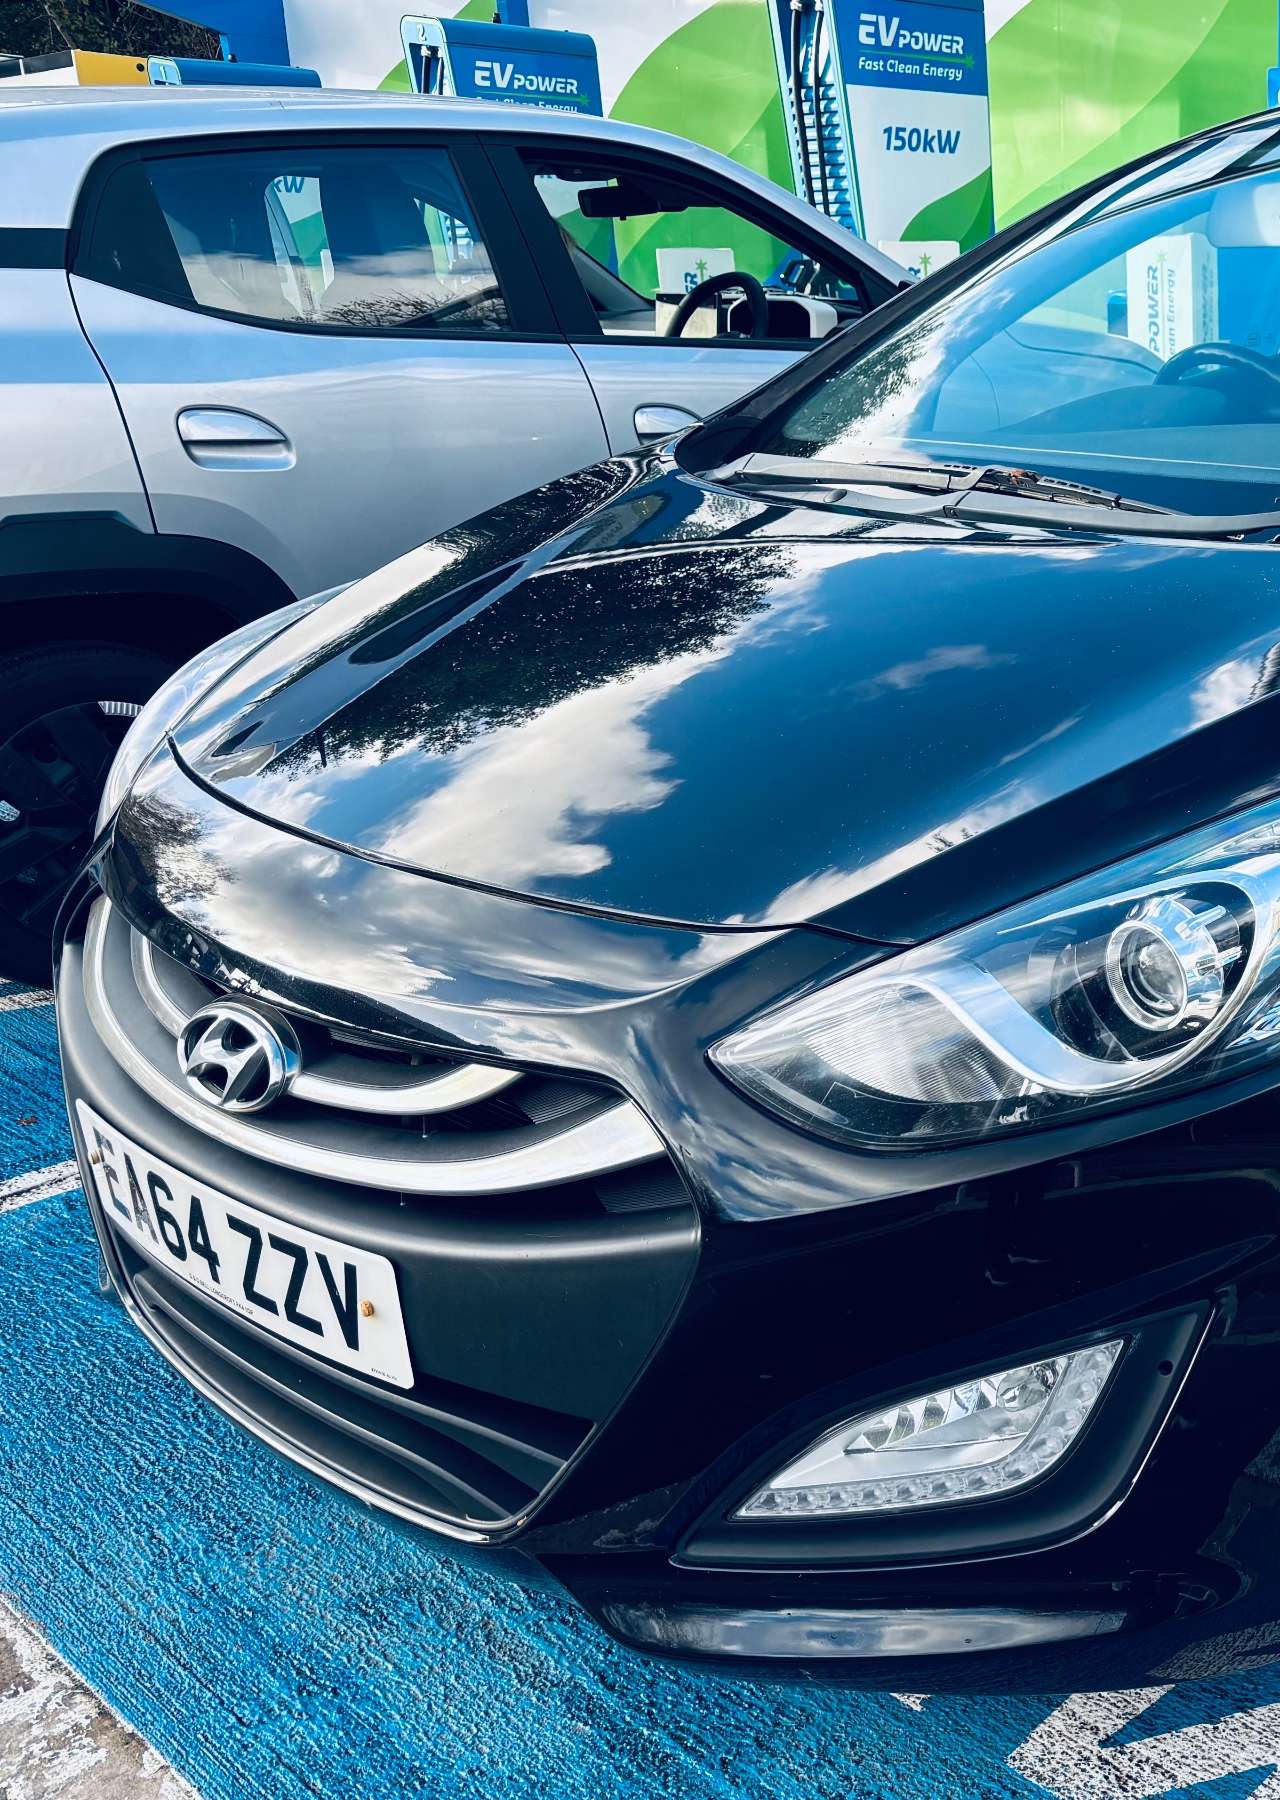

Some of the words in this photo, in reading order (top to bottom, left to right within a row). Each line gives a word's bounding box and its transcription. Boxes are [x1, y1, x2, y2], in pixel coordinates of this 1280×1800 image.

[858, 57, 884, 71] Fast
[886, 59, 920, 75] Clean
[923, 63, 963, 81] Energy
[882, 126, 961, 155] 150kW
[92, 1126, 221, 1285] EA64
[226, 1212, 360, 1352] ZZV
